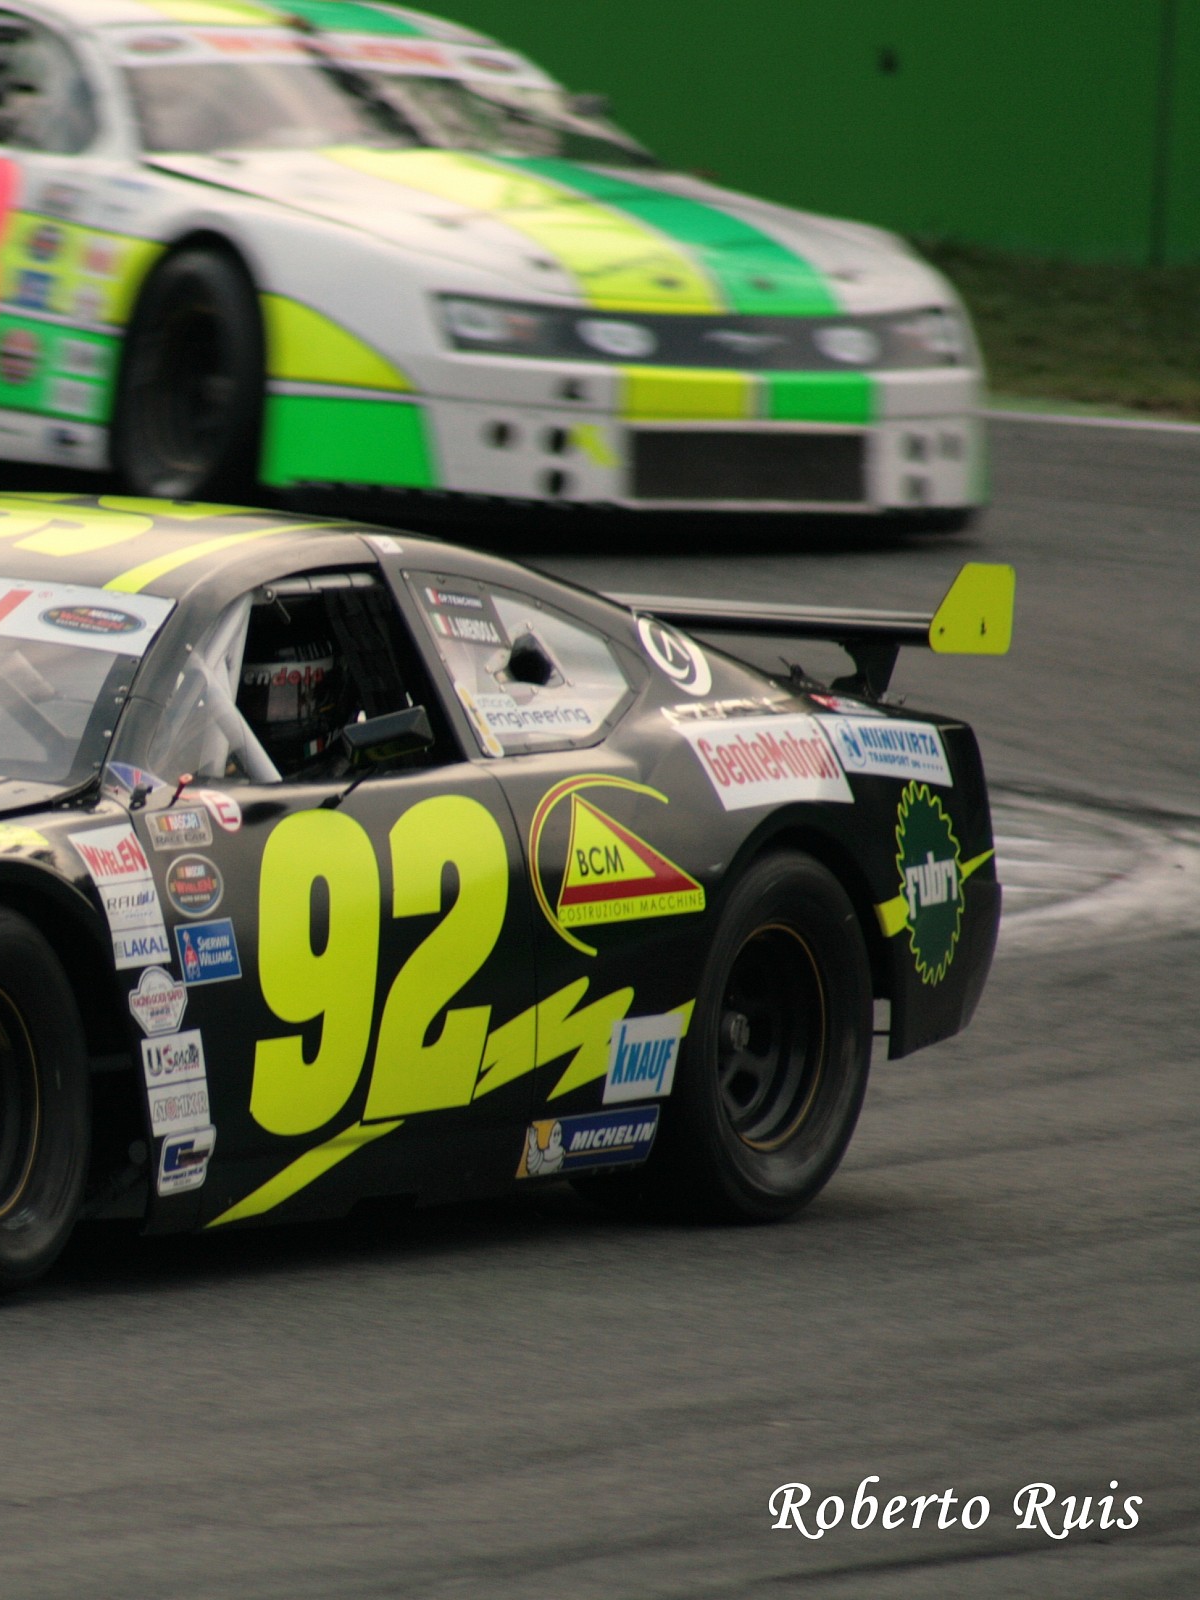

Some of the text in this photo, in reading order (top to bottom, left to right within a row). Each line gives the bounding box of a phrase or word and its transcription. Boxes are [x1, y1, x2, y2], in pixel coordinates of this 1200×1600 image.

[486, 706, 591, 728] engineering
[76, 832, 148, 877] WHELEN
[577, 846, 625, 877] BCM
[558, 892, 705, 922] COSTRUZIONI MACCHINE
[249, 794, 508, 1137] 92
[570, 1120, 657, 1152] MICHELIN
